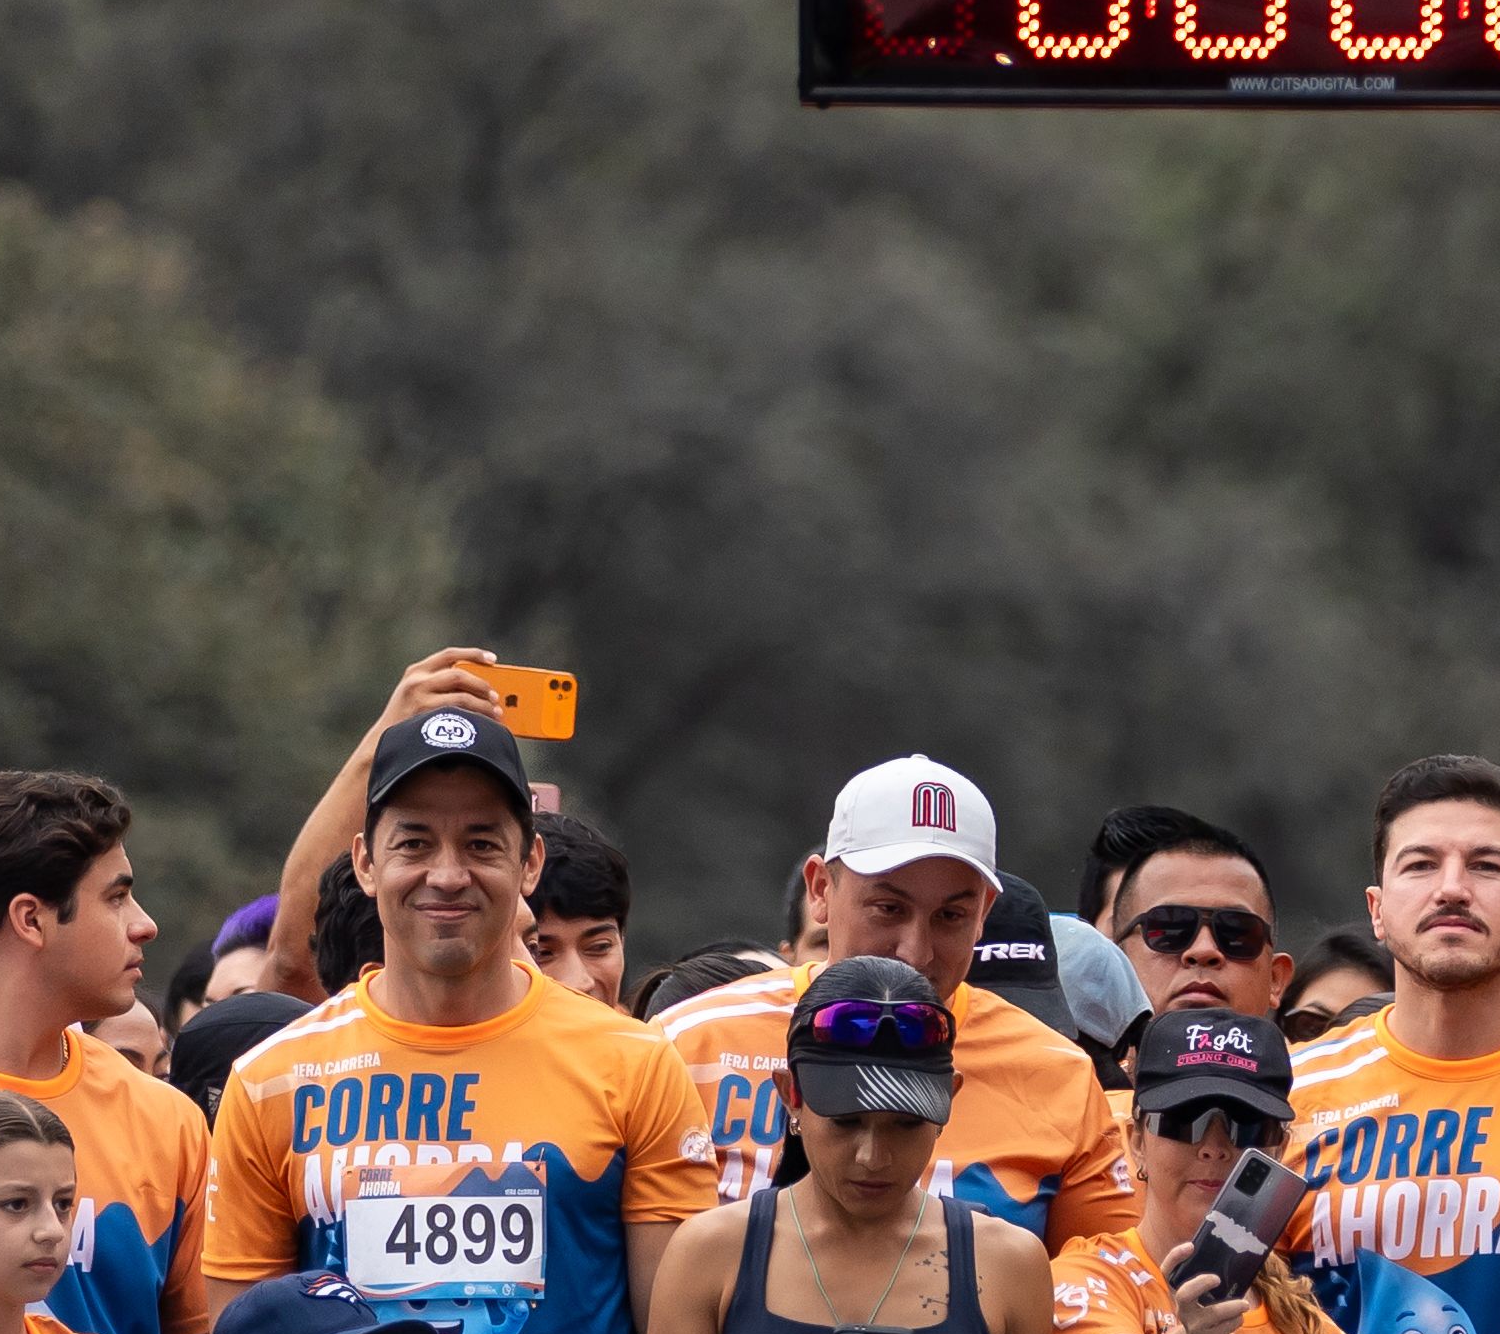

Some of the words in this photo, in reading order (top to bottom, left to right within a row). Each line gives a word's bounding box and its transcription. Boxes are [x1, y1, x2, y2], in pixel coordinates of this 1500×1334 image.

[1229, 76, 1395, 92] WWW.CITSADIGITAL.COM
[293, 1061, 323, 1077] 1ERA
[325, 1051, 381, 1075] CARRERA
[293, 1072, 480, 1155] CORRE
[1304, 1105, 1494, 1190] CORRE
[357, 1180, 401, 1198] AHORRA
[385, 1204, 535, 1266] 4899
